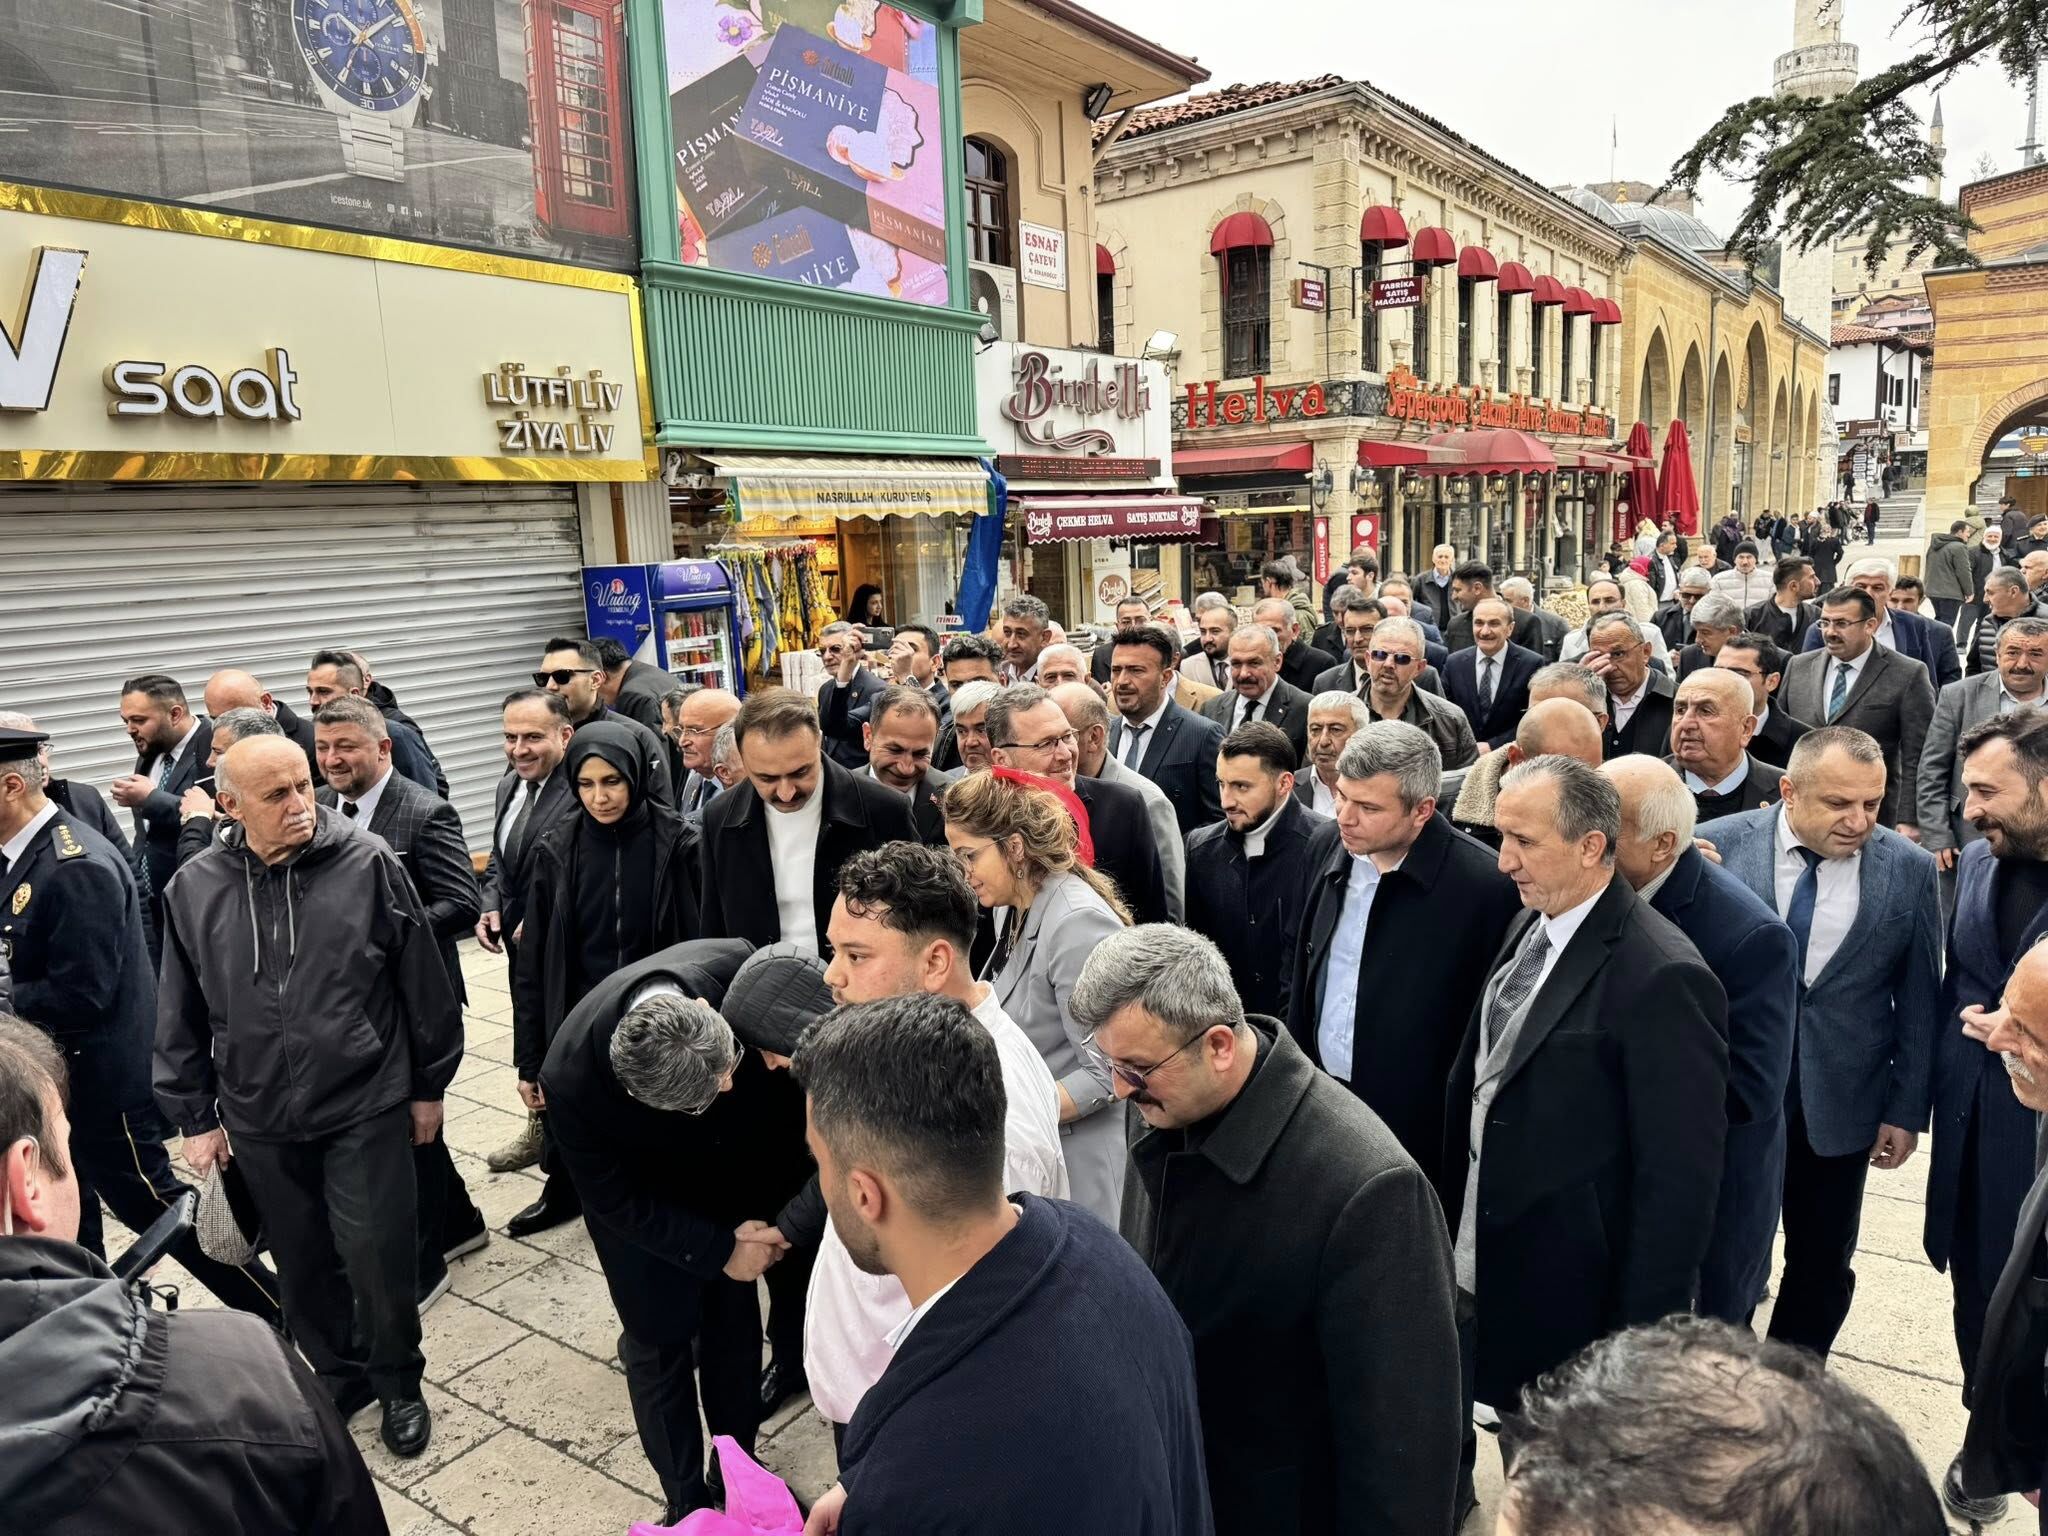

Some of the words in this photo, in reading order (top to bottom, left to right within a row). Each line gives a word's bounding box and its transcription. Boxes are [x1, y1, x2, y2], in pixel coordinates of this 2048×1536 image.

[768, 67, 870, 123] PİŞMANİYE
[330, 193, 373, 210] icestone.uk
[1024, 231, 1059, 254] ESNAF
[1028, 251, 1057, 269] ÇAYEVİ
[1380, 280, 1415, 291] FABRİKA
[1385, 289, 1409, 299] SATIŞ
[1374, 295, 1420, 307] MAĞAZASI
[103, 347, 301, 422] saat
[483, 362, 574, 408] LÜTFİ
[574, 369, 623, 412] LİV
[1000, 351, 1153, 422] Bintelli
[1184, 374, 1329, 430] Helva
[497, 410, 568, 451] ZİYA
[566, 413, 615, 453] LİV
[816, 491, 874, 504] NASRULLAH
[1056, 516, 1087, 530] ÇEKME
[1087, 513, 1114, 527] HELVA
[1126, 511, 1148, 526] SATIŞ
[1148, 510, 1179, 523] NOKTASI
[1318, 541, 1327, 579] SUCUK
[590, 580, 642, 616] Uludağ
